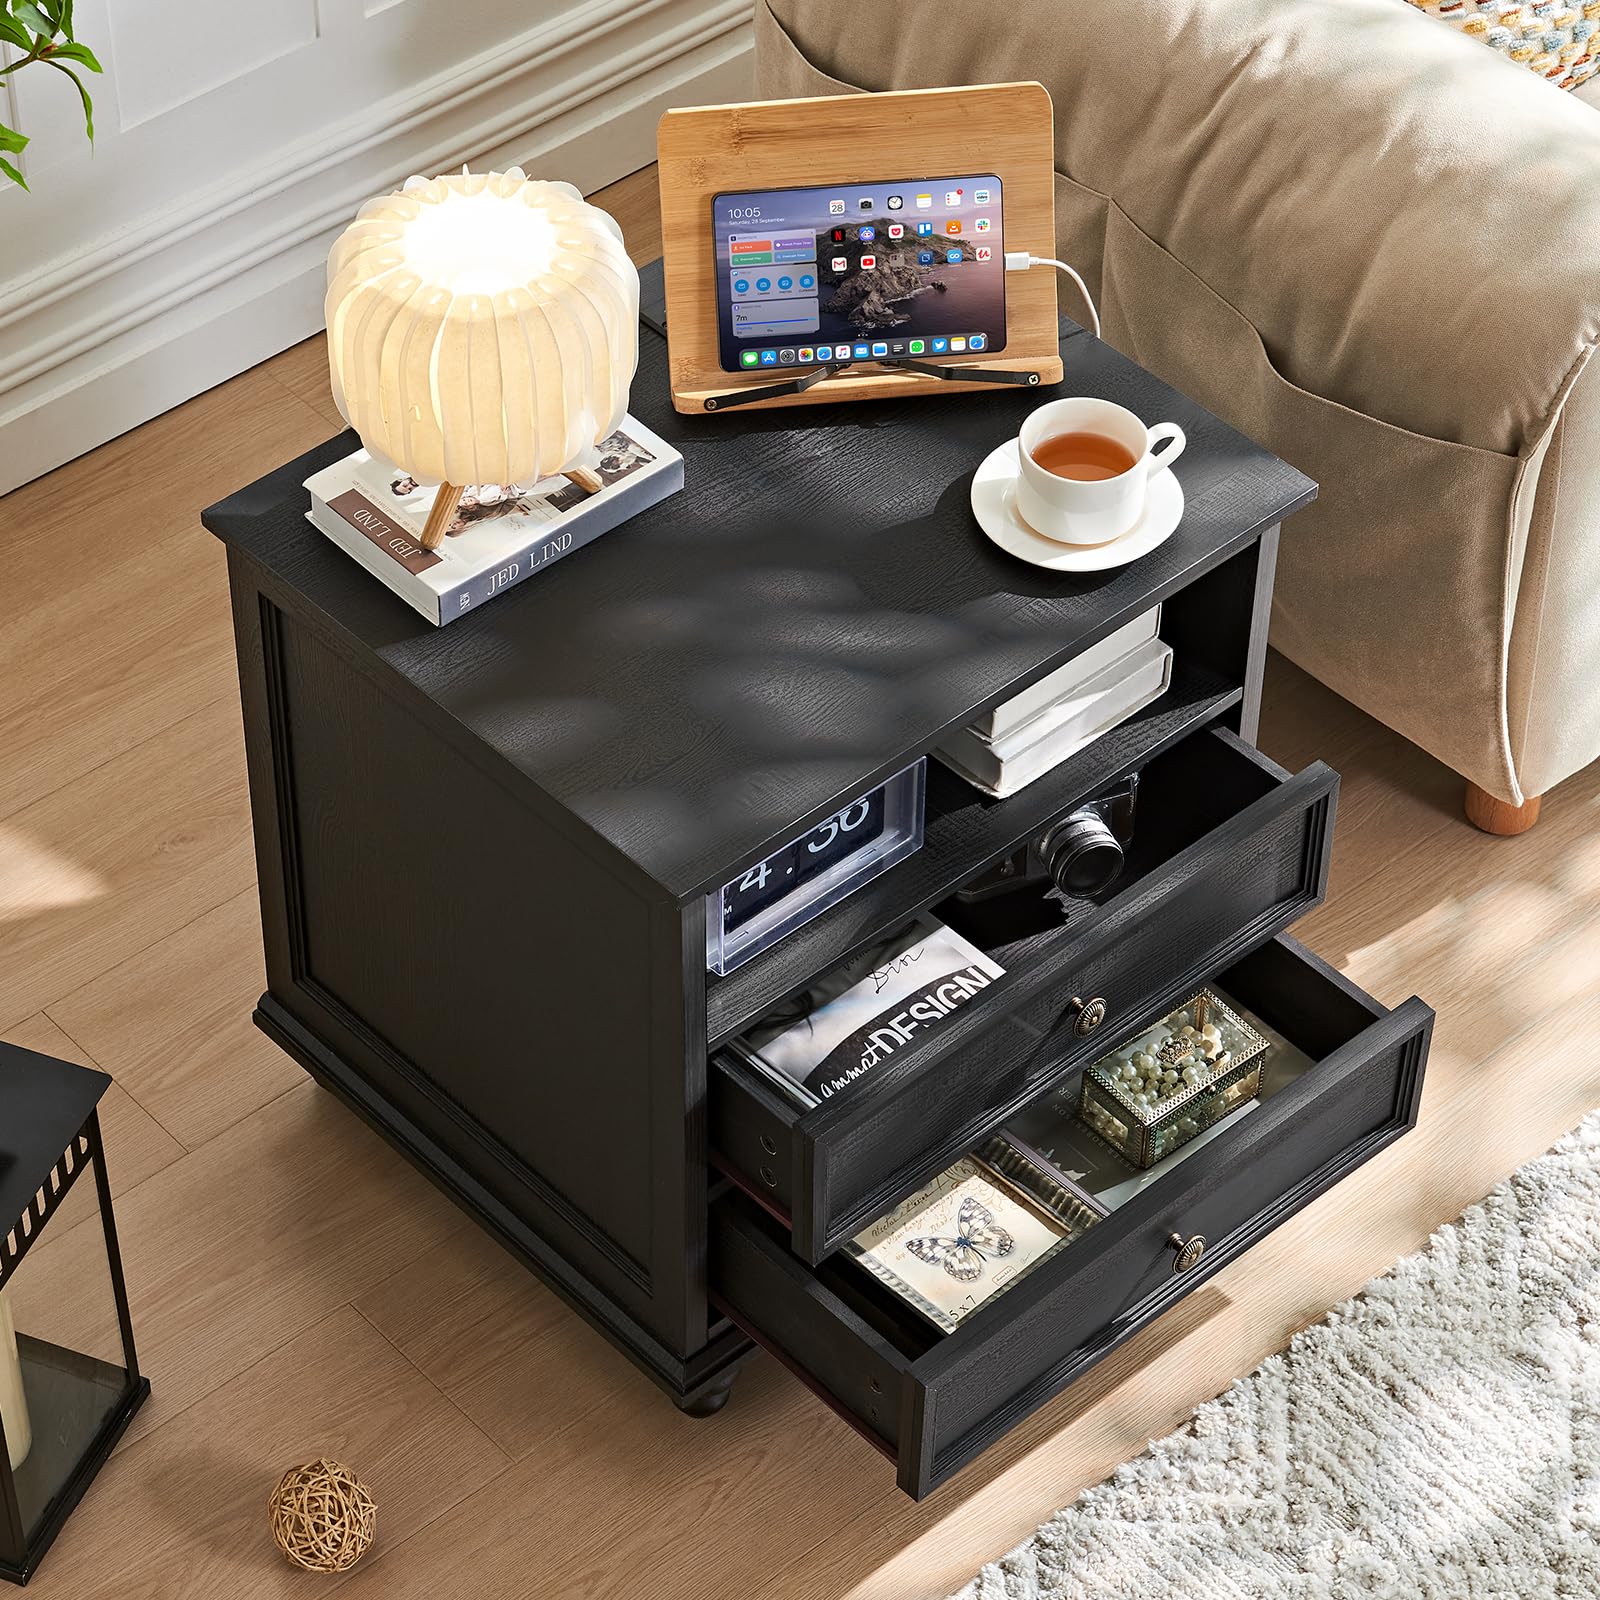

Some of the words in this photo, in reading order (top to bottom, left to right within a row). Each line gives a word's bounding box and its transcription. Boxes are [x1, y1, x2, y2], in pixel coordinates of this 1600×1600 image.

[728, 207, 760, 219] 10:05
[831, 204, 843, 213] 28
[759, 217, 785, 225] September
[736, 314, 748, 322] 7m
[353, 509, 392, 538] LIND
[389, 537, 422, 559] JED
[487, 563, 520, 596] JED
[529, 532, 573, 570] LIND
[868, 965, 992, 1054] DESIGN
[949, 1309, 960, 1320] 5
[965, 1294, 977, 1305] 7
